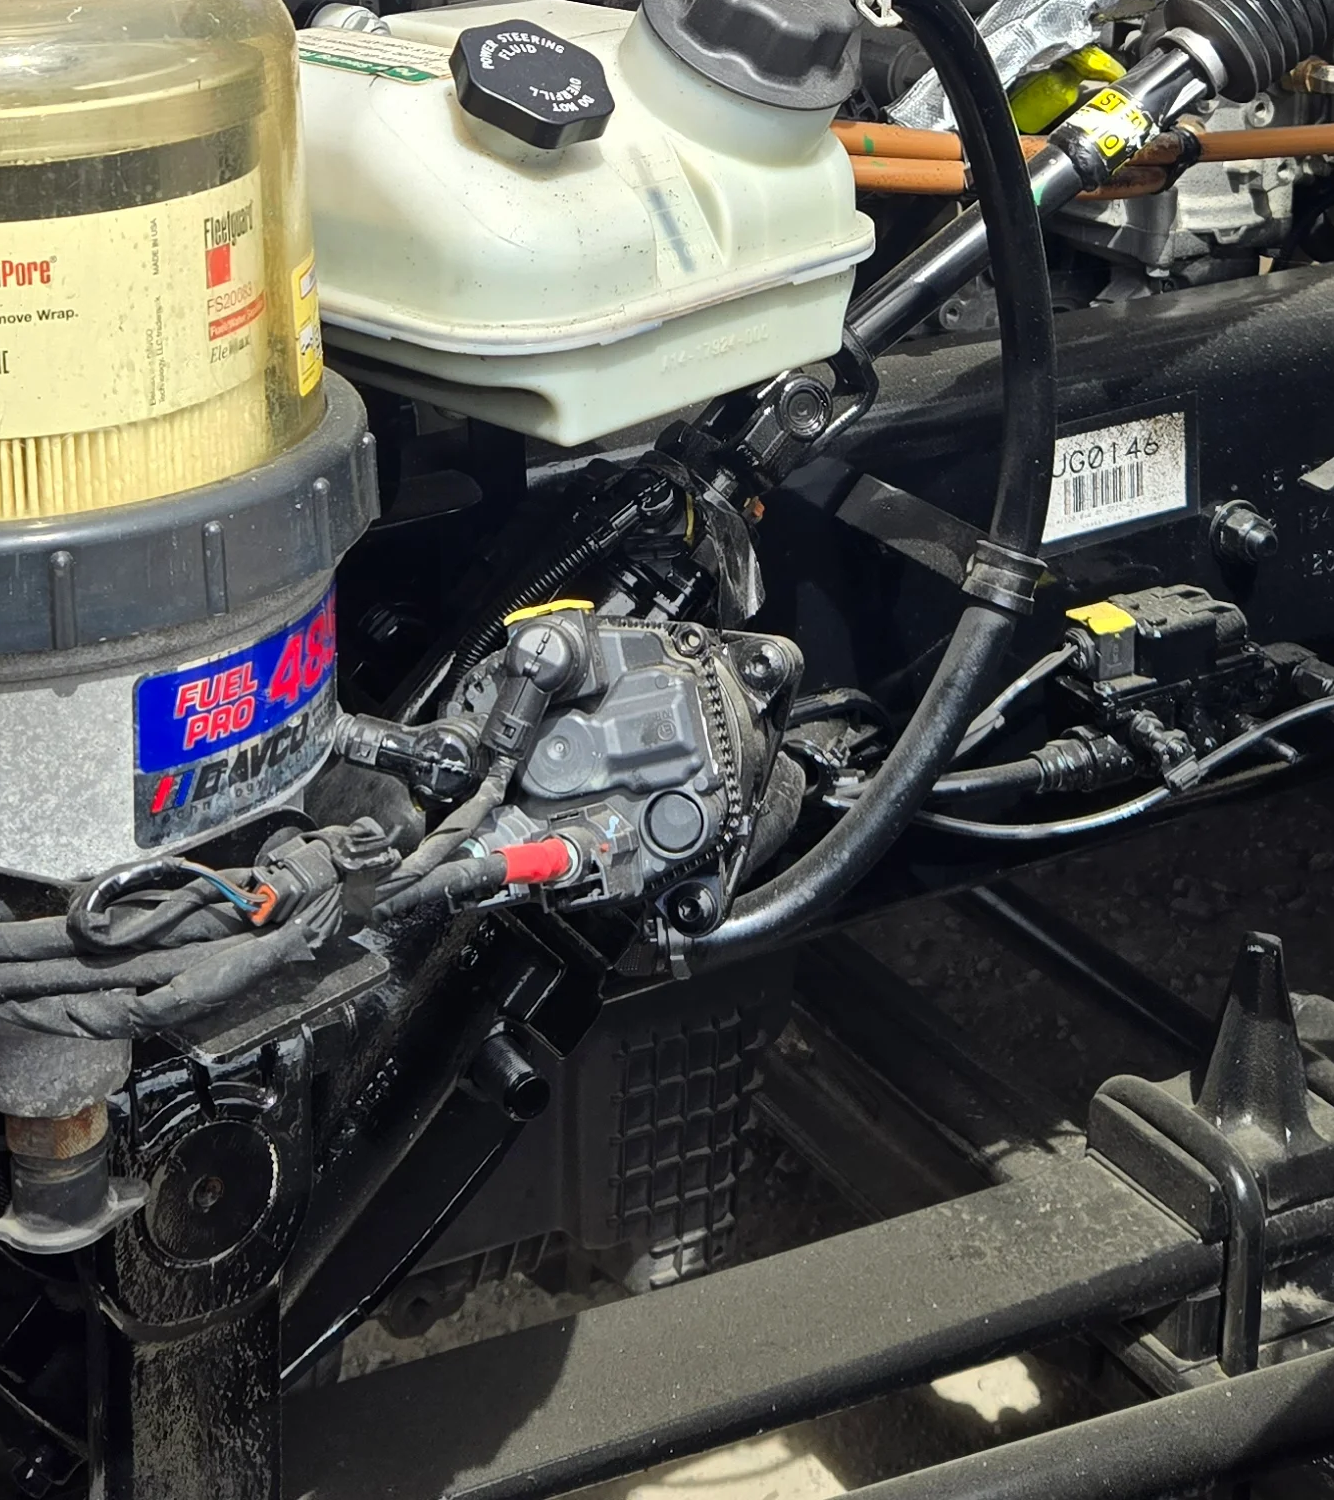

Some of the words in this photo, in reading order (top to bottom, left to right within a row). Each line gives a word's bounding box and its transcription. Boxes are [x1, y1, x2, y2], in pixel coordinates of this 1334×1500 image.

[480, 40, 498, 69] POWER
[497, 32, 564, 54] STEERING
[498, 43, 537, 60] FLUID
[529, 77, 582, 102] OVERFILL
[552, 103, 579, 113] NOT
[578, 95, 595, 108] DO
[150, 218, 158, 236] USA
[152, 238, 159, 248] IN
[37, 307, 79, 324] Wrap.
[173, 661, 258, 720] FUEL
[184, 696, 256, 750] PRO
